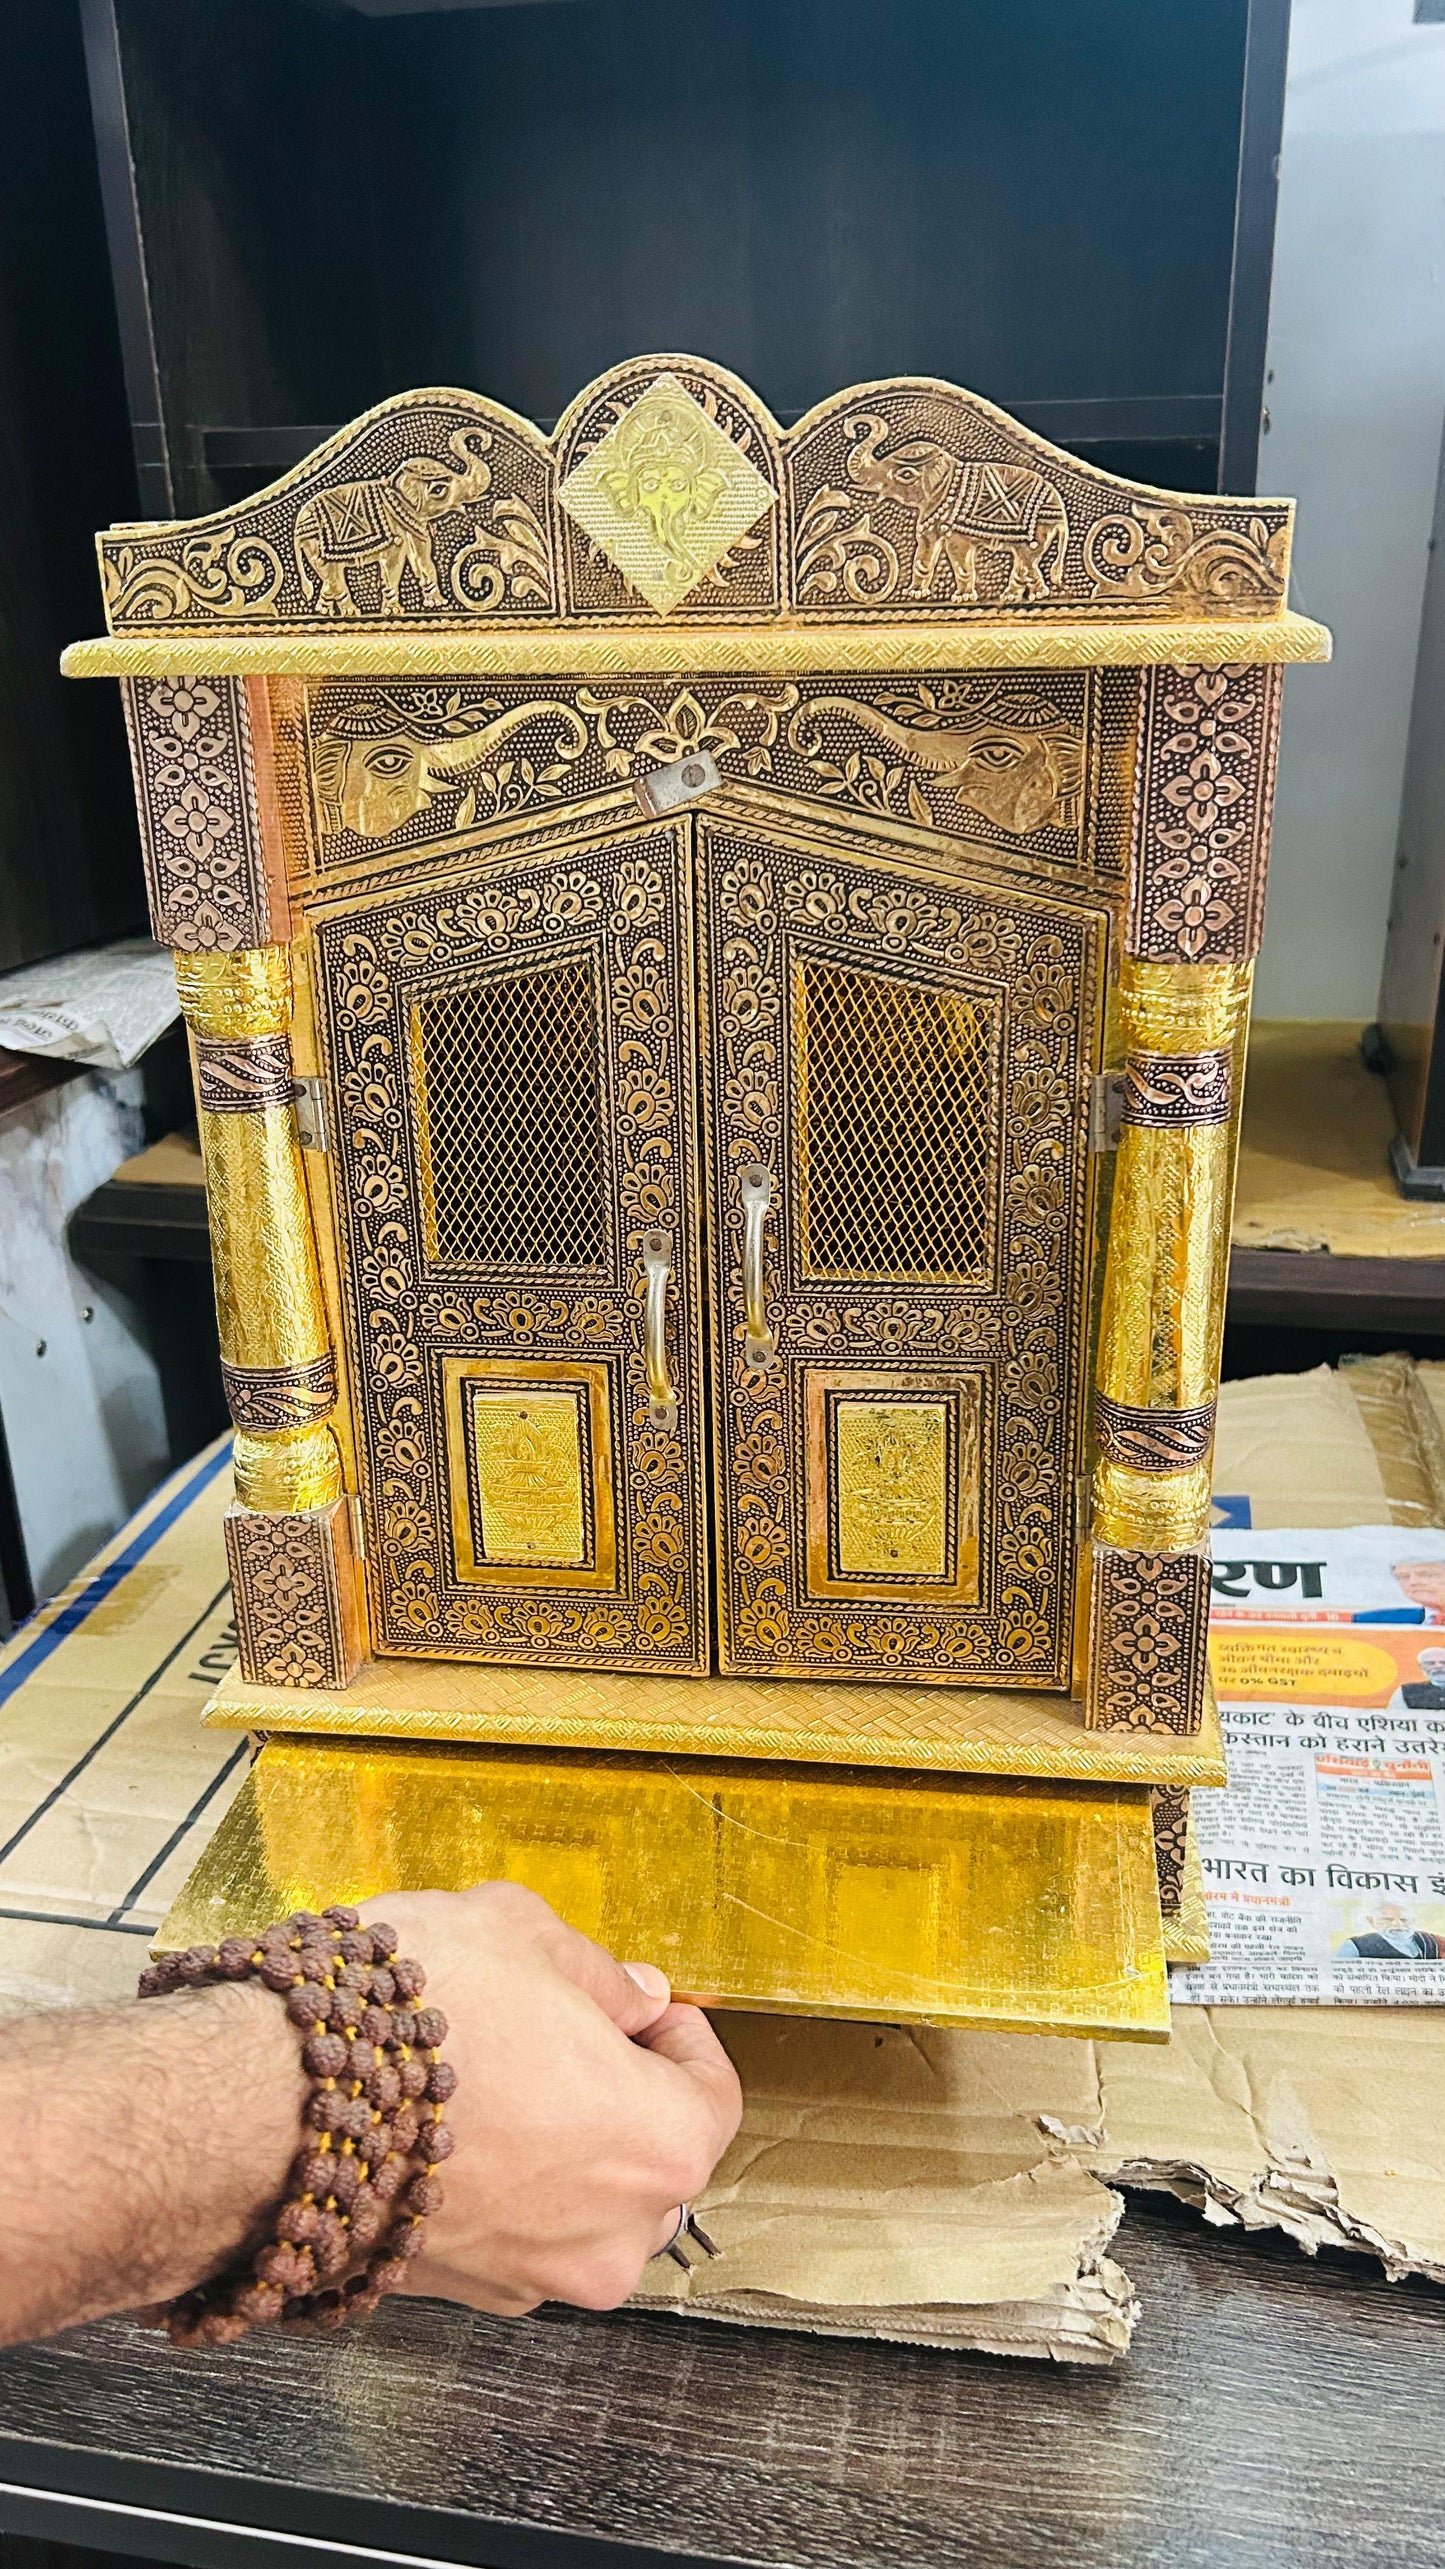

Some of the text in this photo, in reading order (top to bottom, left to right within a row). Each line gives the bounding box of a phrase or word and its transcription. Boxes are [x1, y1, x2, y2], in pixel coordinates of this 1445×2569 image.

[1240, 1678, 1264, 1686] 0%
[1268, 1678, 1297, 1686] GST
[1285, 1709, 1305, 1727] के
[1357, 1714, 1418, 1732] एशिया
[1299, 1732, 1328, 1749] को
[1336, 1733, 1386, 1752] हराने
[1201, 1857, 1270, 1883] भारत
[1279, 1864, 1317, 1887] का
[1325, 1862, 1419, 1893] विकास
